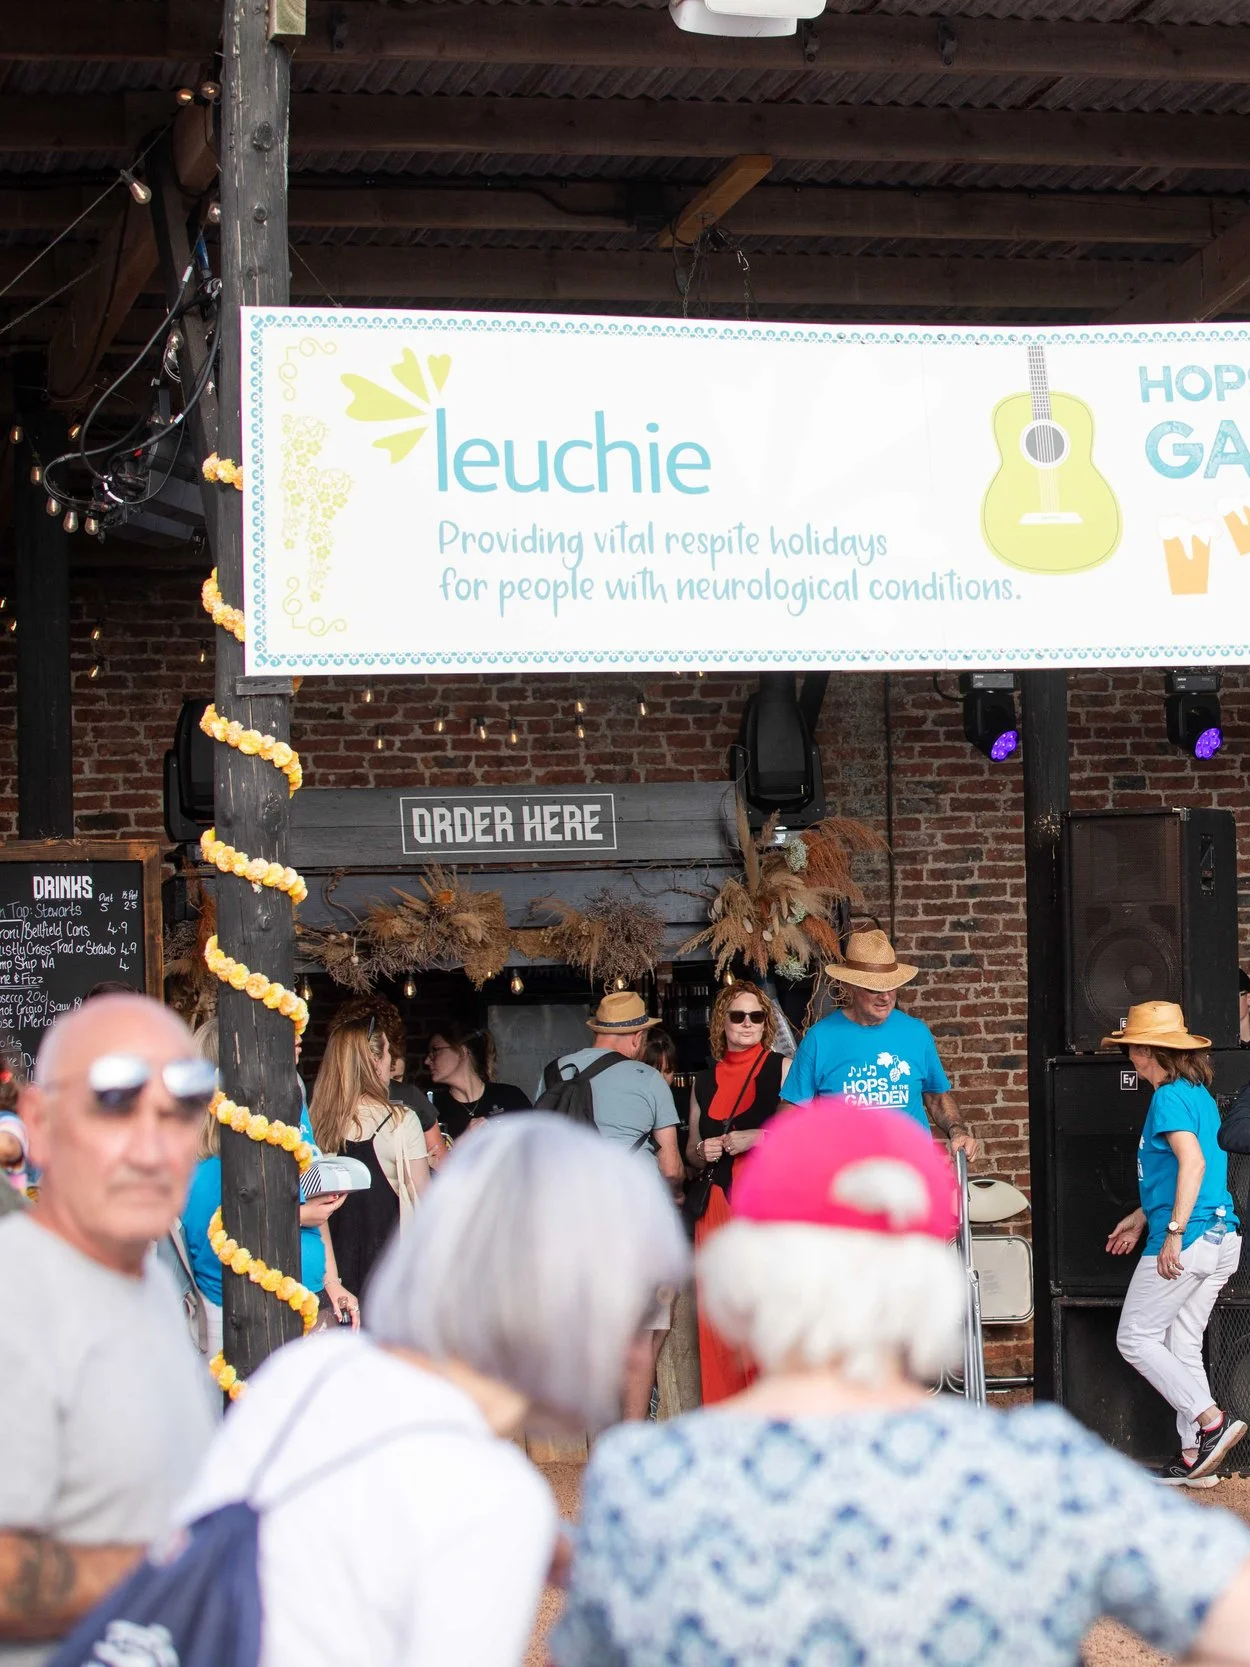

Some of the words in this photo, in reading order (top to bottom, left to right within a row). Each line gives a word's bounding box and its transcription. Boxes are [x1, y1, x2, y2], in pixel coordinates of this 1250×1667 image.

[436, 407, 712, 495] leuchie
[438, 520, 584, 570] Providing
[594, 520, 653, 555] vital
[665, 522, 759, 571] respite
[770, 522, 887, 566] holidays
[438, 567, 488, 601] for
[499, 568, 595, 618] people
[606, 567, 668, 604] with
[676, 568, 858, 618] neurological
[869, 568, 1022, 601] conditions.
[411, 806, 514, 844] ORDER
[522, 804, 604, 842] HERE
[32, 875, 93, 899] DRINKS
[99, 902, 110, 912] 5
[119, 958, 130, 971] 4
[21, 971, 44, 985] Fizz
[842, 1077, 889, 1094] HOPS
[844, 1090, 909, 1107] GARDEN
